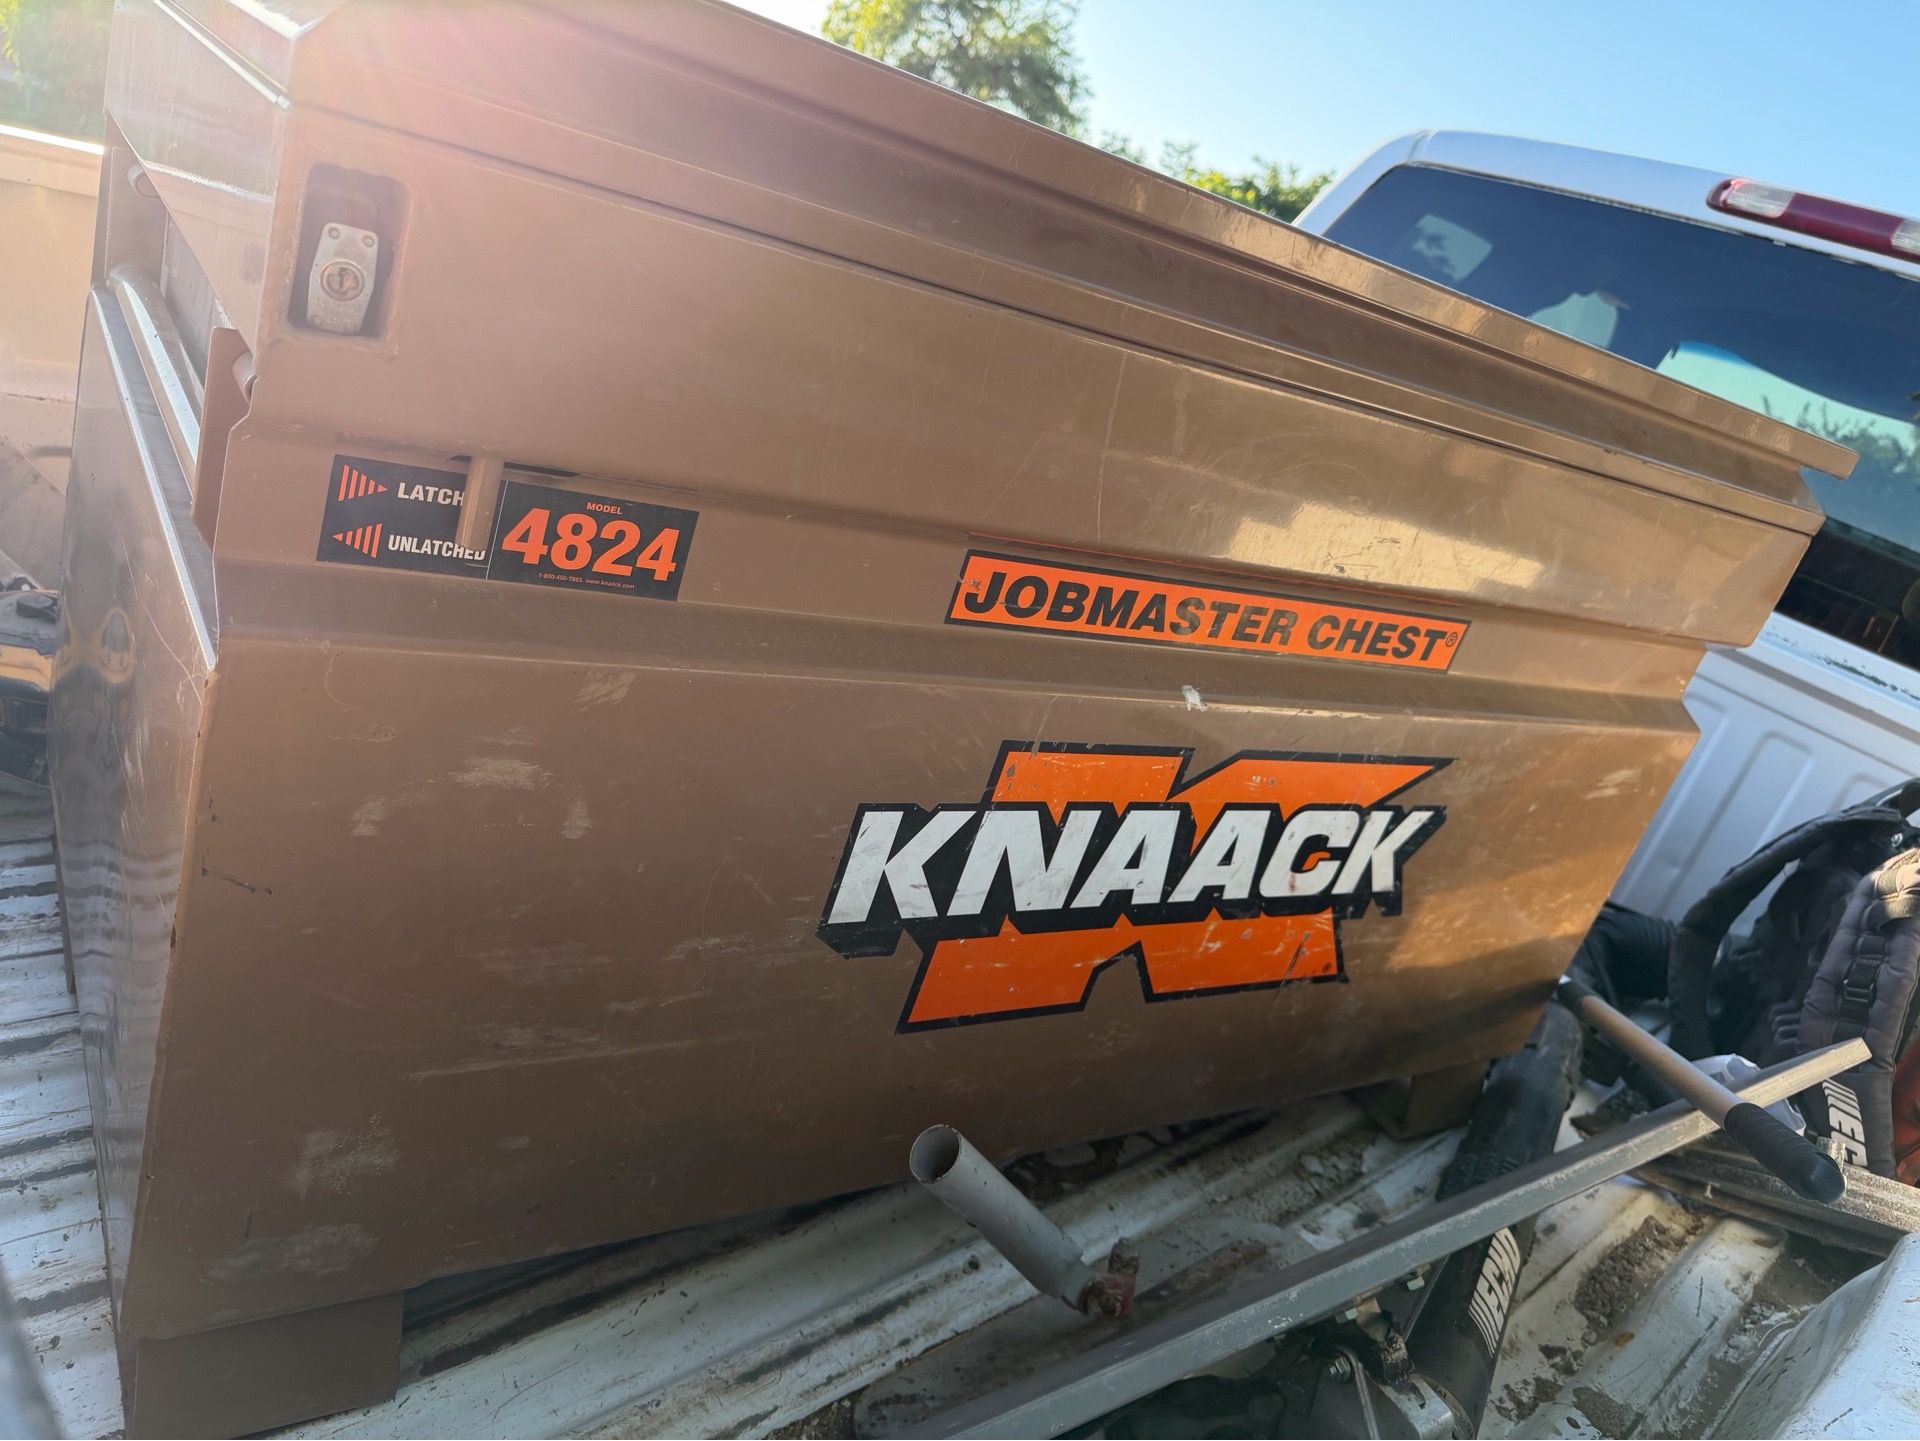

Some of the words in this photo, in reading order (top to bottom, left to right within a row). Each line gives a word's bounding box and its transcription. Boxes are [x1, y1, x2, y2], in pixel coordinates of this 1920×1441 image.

[398, 482, 465, 507] LATCH
[586, 502, 623, 515] MODEL
[388, 534, 486, 561] UNLATCHED
[502, 507, 680, 582] 4824
[964, 570, 1299, 646] JOBMASTER
[827, 809, 1434, 925] KNAACK
